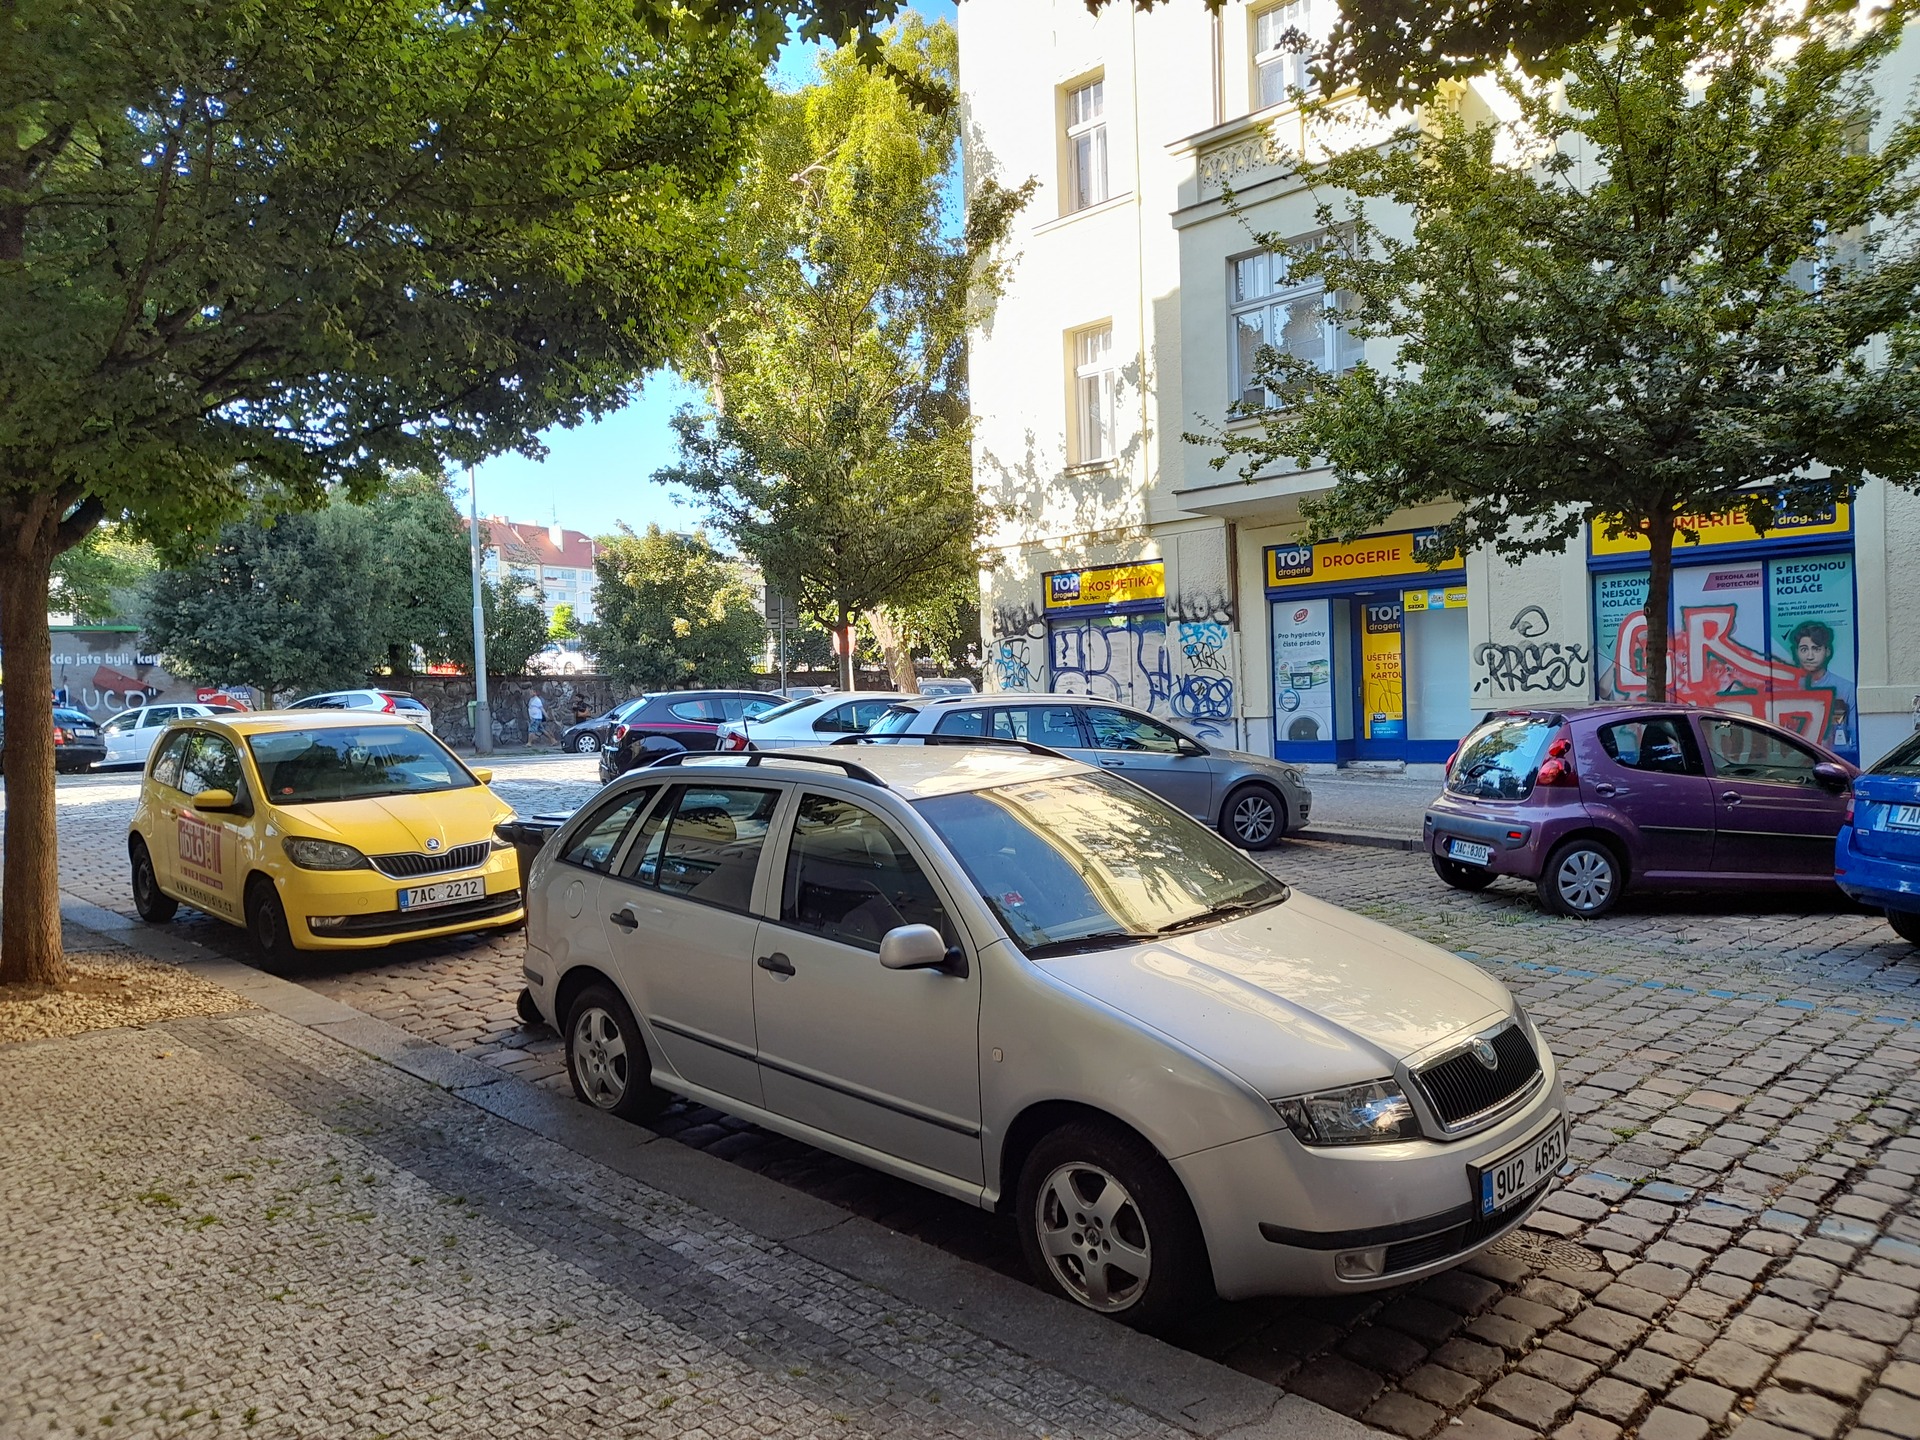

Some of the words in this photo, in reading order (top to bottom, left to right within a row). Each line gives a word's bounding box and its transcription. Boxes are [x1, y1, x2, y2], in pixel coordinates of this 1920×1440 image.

[1778, 511, 1832, 525] drogie
[1277, 550, 1311, 567] TOP
[1322, 548, 1401, 568] DROGERIE
[1277, 566, 1311, 577] drogerie
[1776, 566, 1783, 575] S
[1785, 561, 1846, 574] REXONOU
[1088, 575, 1155, 592] KOSMETIKA
[1715, 573, 1744, 581] REXONA
[1776, 573, 1820, 585] NEJSOU
[1053, 577, 1079, 591] TOP
[1601, 581, 1608, 589] S
[1716, 580, 1760, 588] PROTECTION
[1776, 583, 1824, 596] KOLÁČE
[1053, 591, 1079, 600] drogerie
[1602, 588, 1640, 599] NEJSOU
[1602, 597, 1642, 608] KOLÁČE
[1369, 606, 1401, 622] TOP
[1290, 631, 1326, 640] hygienicky
[1282, 640, 1298, 648] čisté
[76, 653, 102, 666] jste
[105, 653, 133, 666] byli,
[1383, 662, 1399, 670] TOP
[1470, 845, 1487, 859] 8303
[410, 888, 436, 905] 7AC
[446, 881, 478, 899] 2212
[1484, 1196, 1493, 1209] CZ
[1496, 1159, 1525, 1201] 9U2
[1534, 1130, 1561, 1176] 4653
